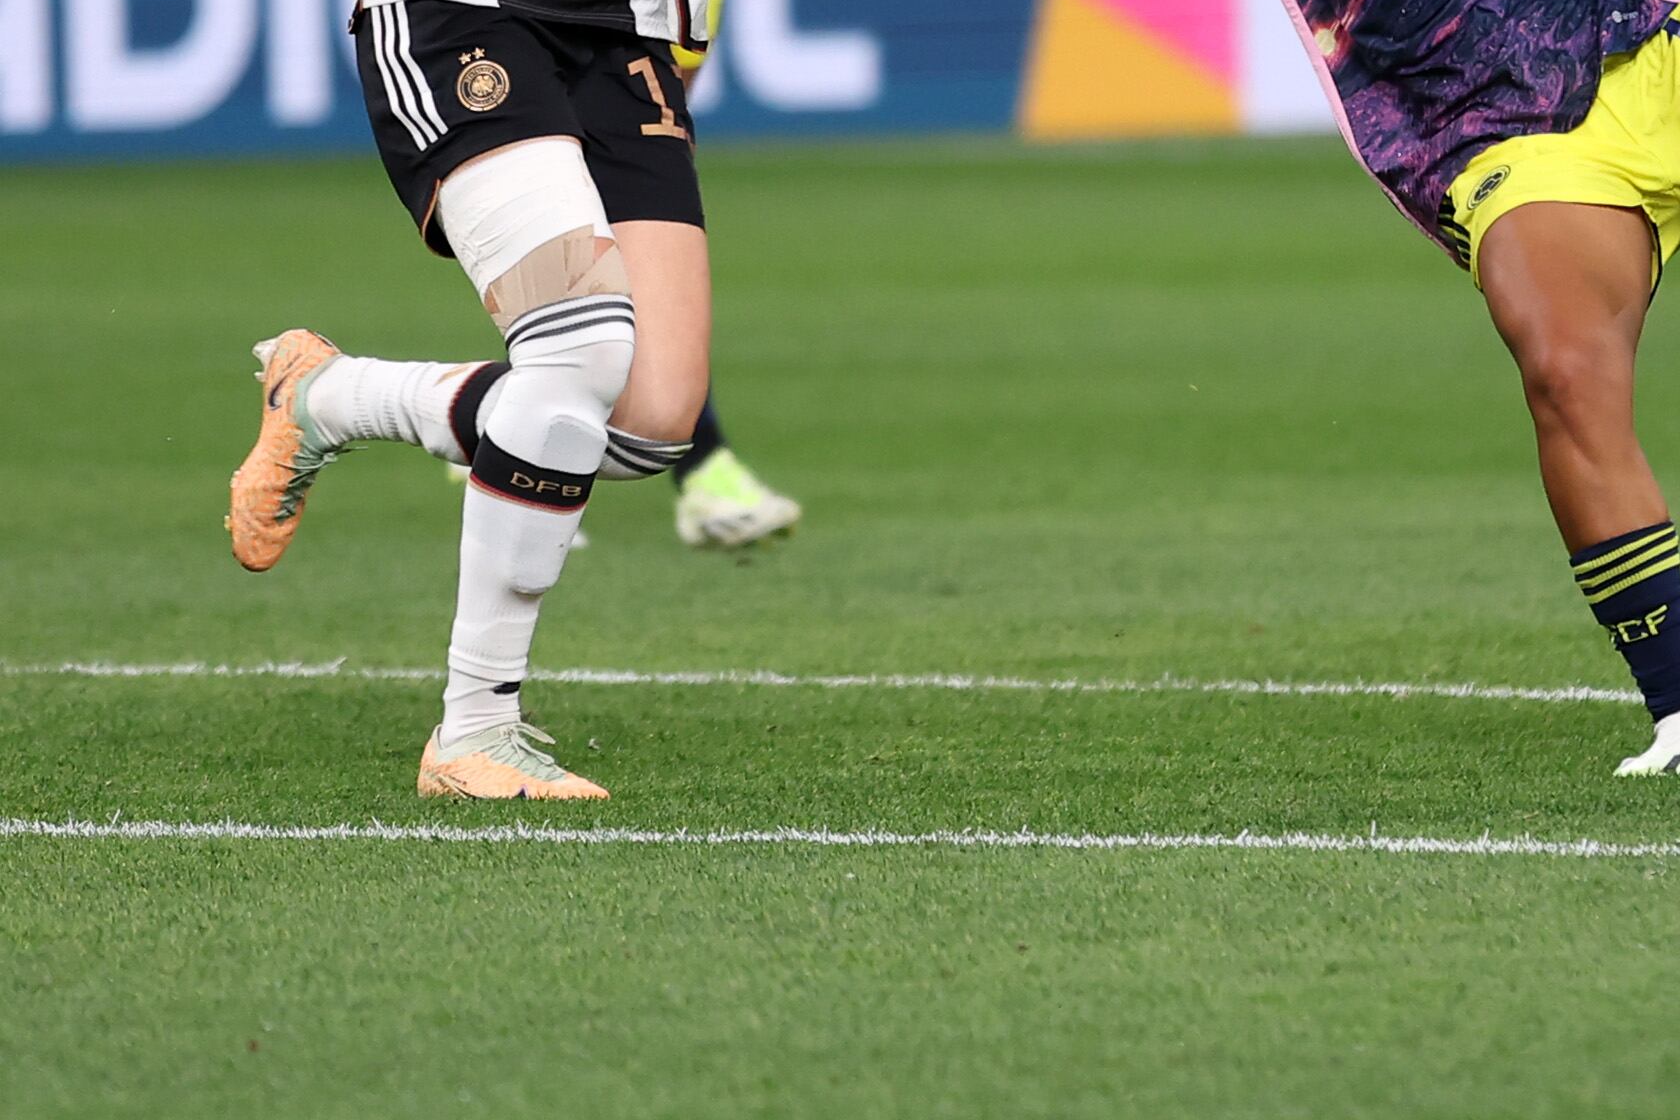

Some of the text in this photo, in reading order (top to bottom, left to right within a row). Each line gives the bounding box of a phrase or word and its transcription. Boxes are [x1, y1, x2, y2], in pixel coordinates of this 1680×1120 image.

[627, 56, 694, 146] 1
[510, 471, 582, 497] DFB
[1610, 604, 1668, 644] CF
